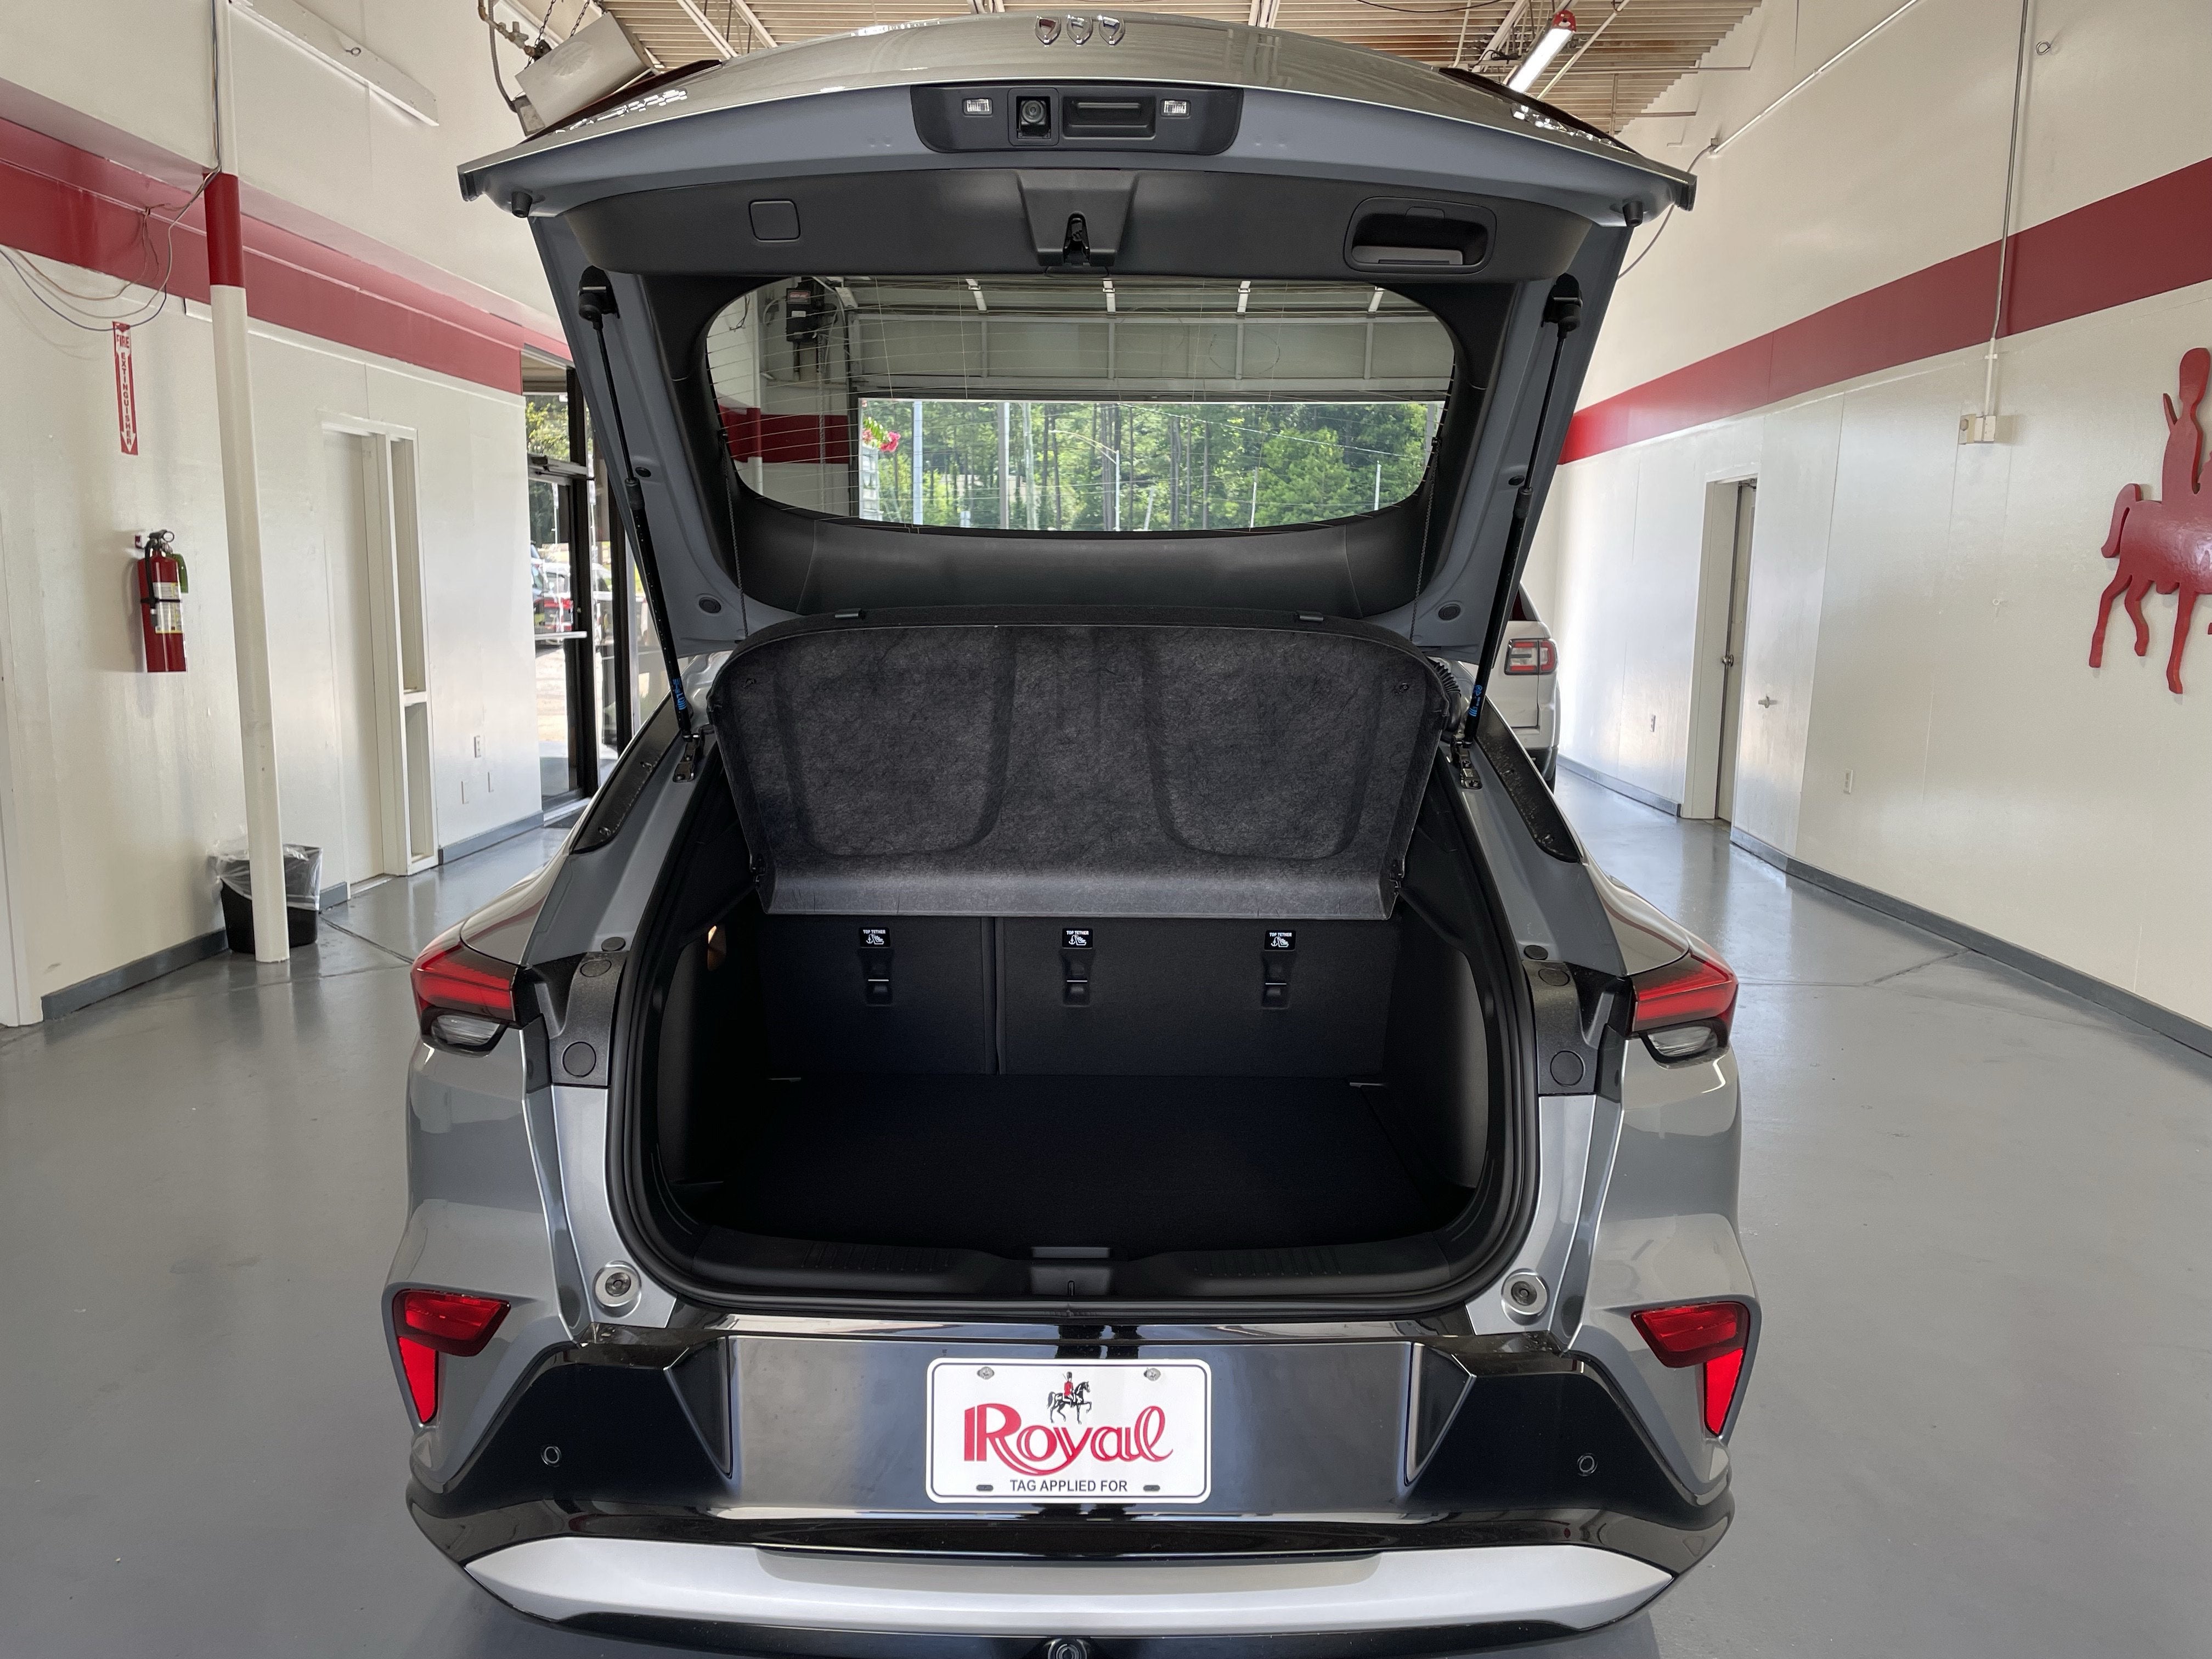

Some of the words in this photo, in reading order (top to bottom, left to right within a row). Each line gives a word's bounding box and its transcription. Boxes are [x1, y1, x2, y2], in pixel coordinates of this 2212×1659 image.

[116, 334, 129, 348] FIRE
[121, 352, 132, 445] EXTINGUISHER
[963, 1403, 1173, 1476] Royal
[1009, 1480, 1036, 1492] TAG
[1040, 1480, 1096, 1492] APPLIED
[1101, 1480, 1128, 1492] FOR
